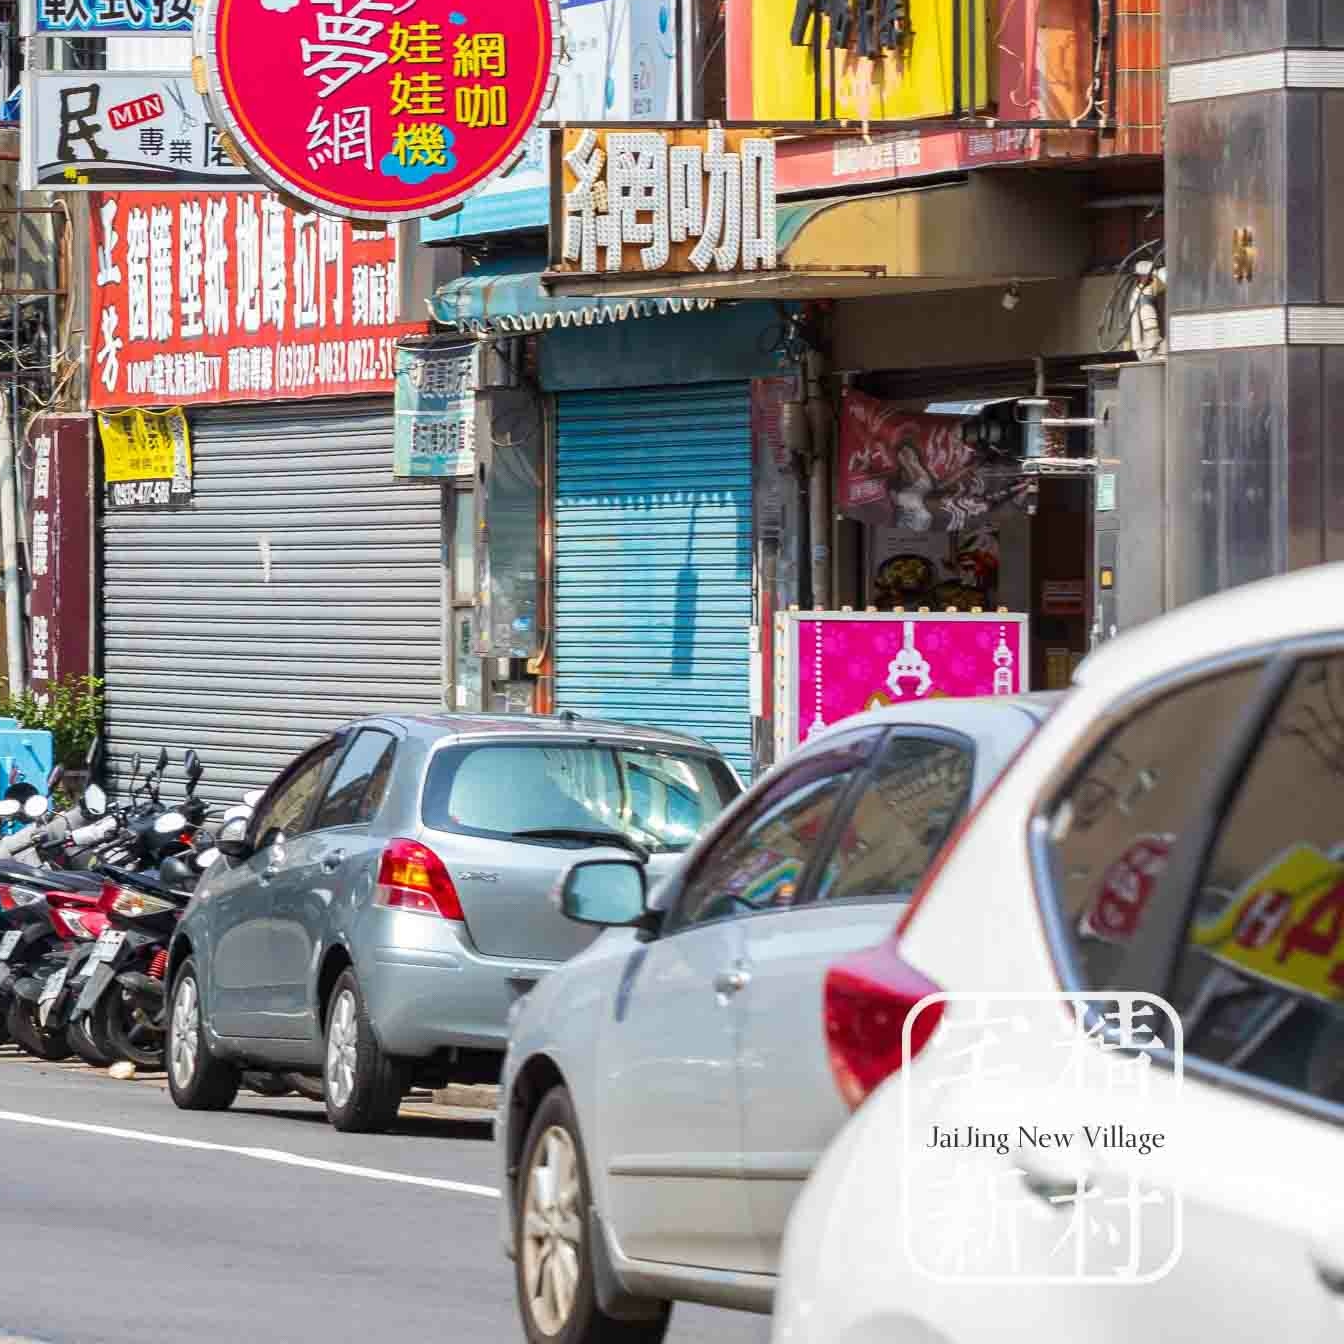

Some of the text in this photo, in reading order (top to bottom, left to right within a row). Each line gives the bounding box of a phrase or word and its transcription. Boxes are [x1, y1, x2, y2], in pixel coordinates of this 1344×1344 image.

[57, 83, 109, 161] 民
[111, 97, 163, 128] MIN
[388, 20, 446, 168] 娃娃機
[452, 32, 507, 129] 網咖
[563, 128, 776, 273] 網咖
[180, 198, 229, 340] 壁紙
